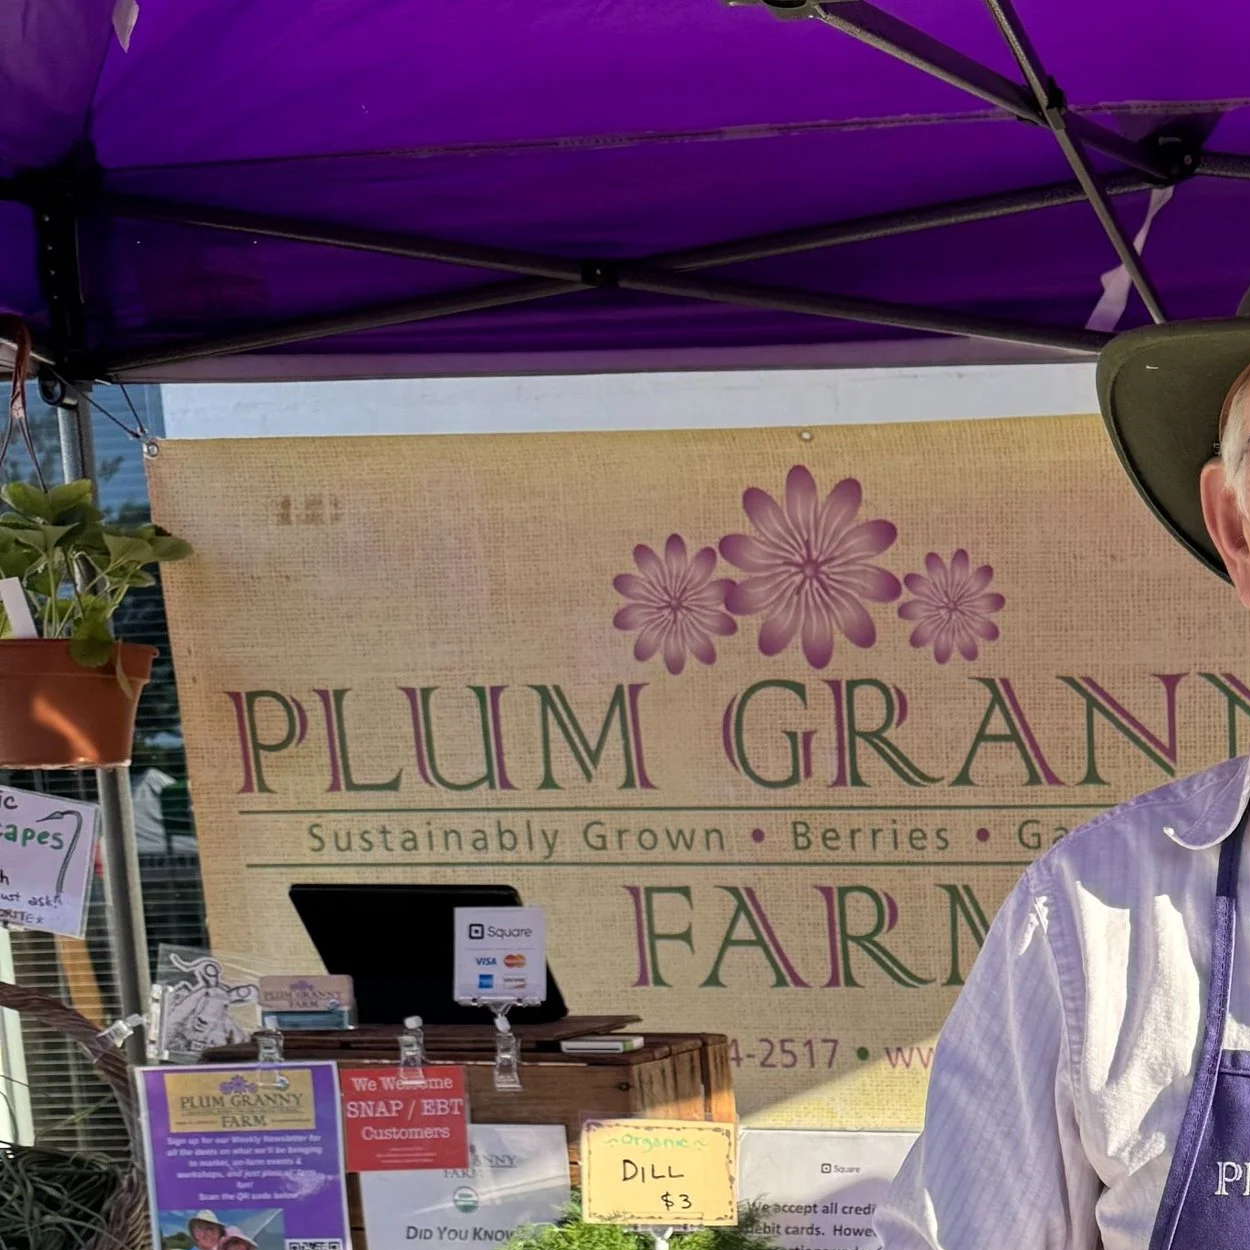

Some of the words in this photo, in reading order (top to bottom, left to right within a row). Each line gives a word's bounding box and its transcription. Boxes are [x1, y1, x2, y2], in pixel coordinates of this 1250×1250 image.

[223, 682, 659, 794] PLUM
[0, 823, 64, 850] apes
[308, 820, 559, 860] Sustainably
[582, 820, 726, 852] Grown
[791, 820, 950, 851] Berries
[487, 926, 532, 939] Square
[475, 957, 497, 966] VISA
[351, 1077, 377, 1091] We
[379, 1076, 453, 1090] Weme
[180, 1096, 225, 1109] PLUM
[230, 1092, 303, 1107] GRANNY
[346, 1099, 404, 1118] SNAP
[407, 1099, 417, 1121] /
[420, 1098, 464, 1116] EBT
[221, 1114, 268, 1127] FARM
[361, 1125, 451, 1141] Customers
[622, 1159, 684, 1183] DILL
[834, 1165, 861, 1174] Square
[660, 1191, 692, 1212] $3
[773, 1203, 818, 1216] accept
[822, 1203, 838, 1214] all
[784, 1224, 825, 1236] cards.
